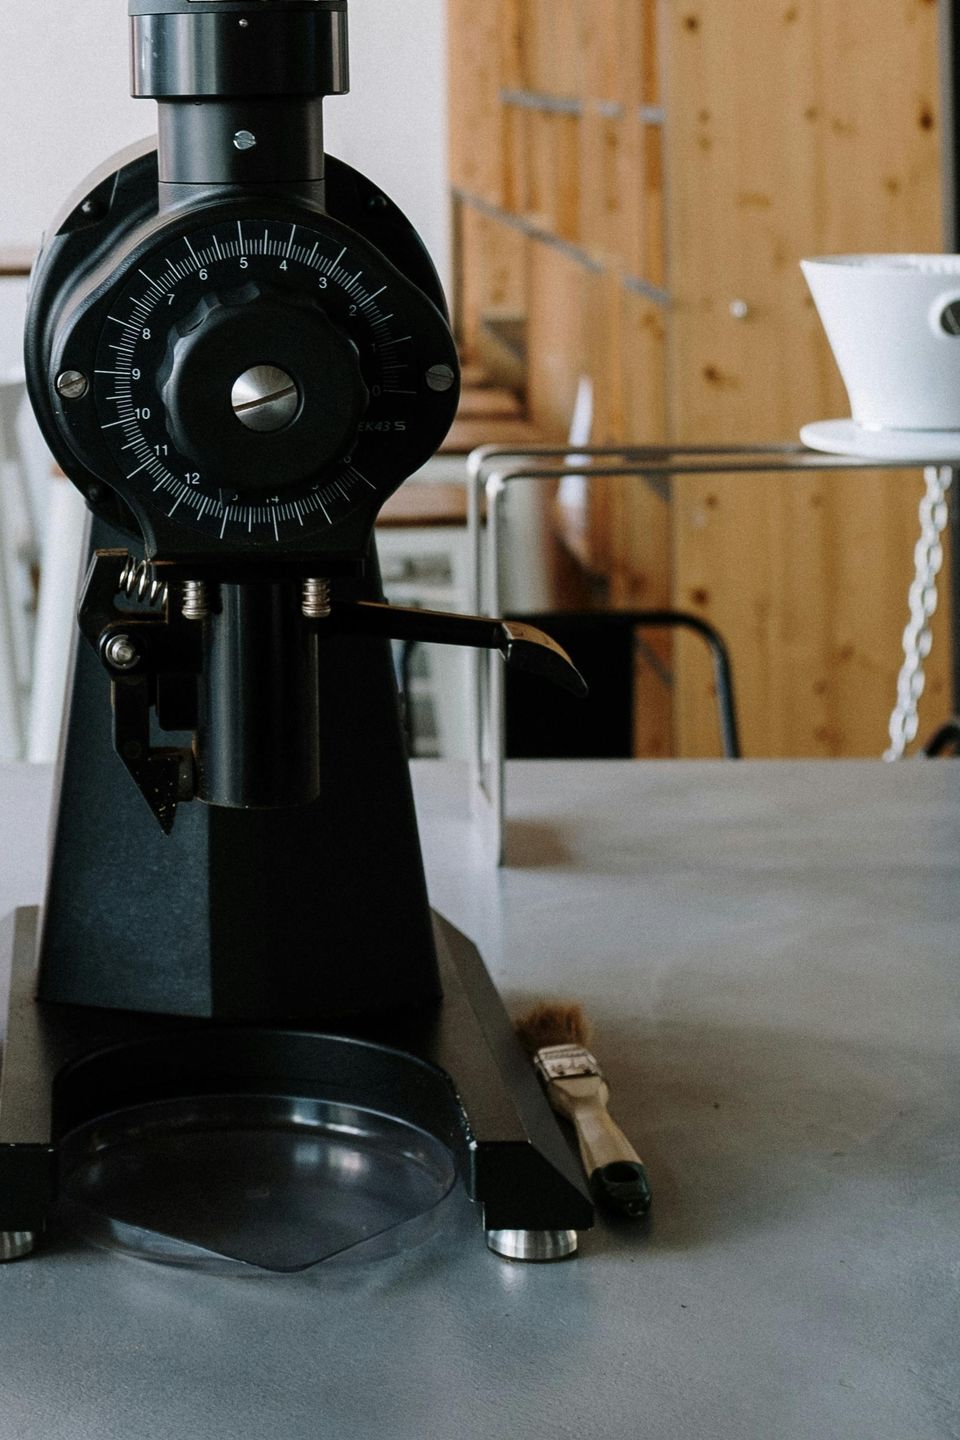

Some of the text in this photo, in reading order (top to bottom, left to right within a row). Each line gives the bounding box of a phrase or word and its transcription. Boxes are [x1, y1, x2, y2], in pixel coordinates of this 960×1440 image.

[239, 257, 249, 269] 5
[279, 260, 288, 271] 4
[199, 269, 208, 281] 6
[318, 277, 328, 289] 3
[166, 293, 176, 305] 7
[348, 304, 357, 316] 2
[142, 328, 151, 340] 8
[131, 368, 141, 380] 9
[371, 384, 381, 396] 0
[134, 408, 151, 420] 10
[153, 445, 168, 456] 11
[184, 472, 200, 485] 12
